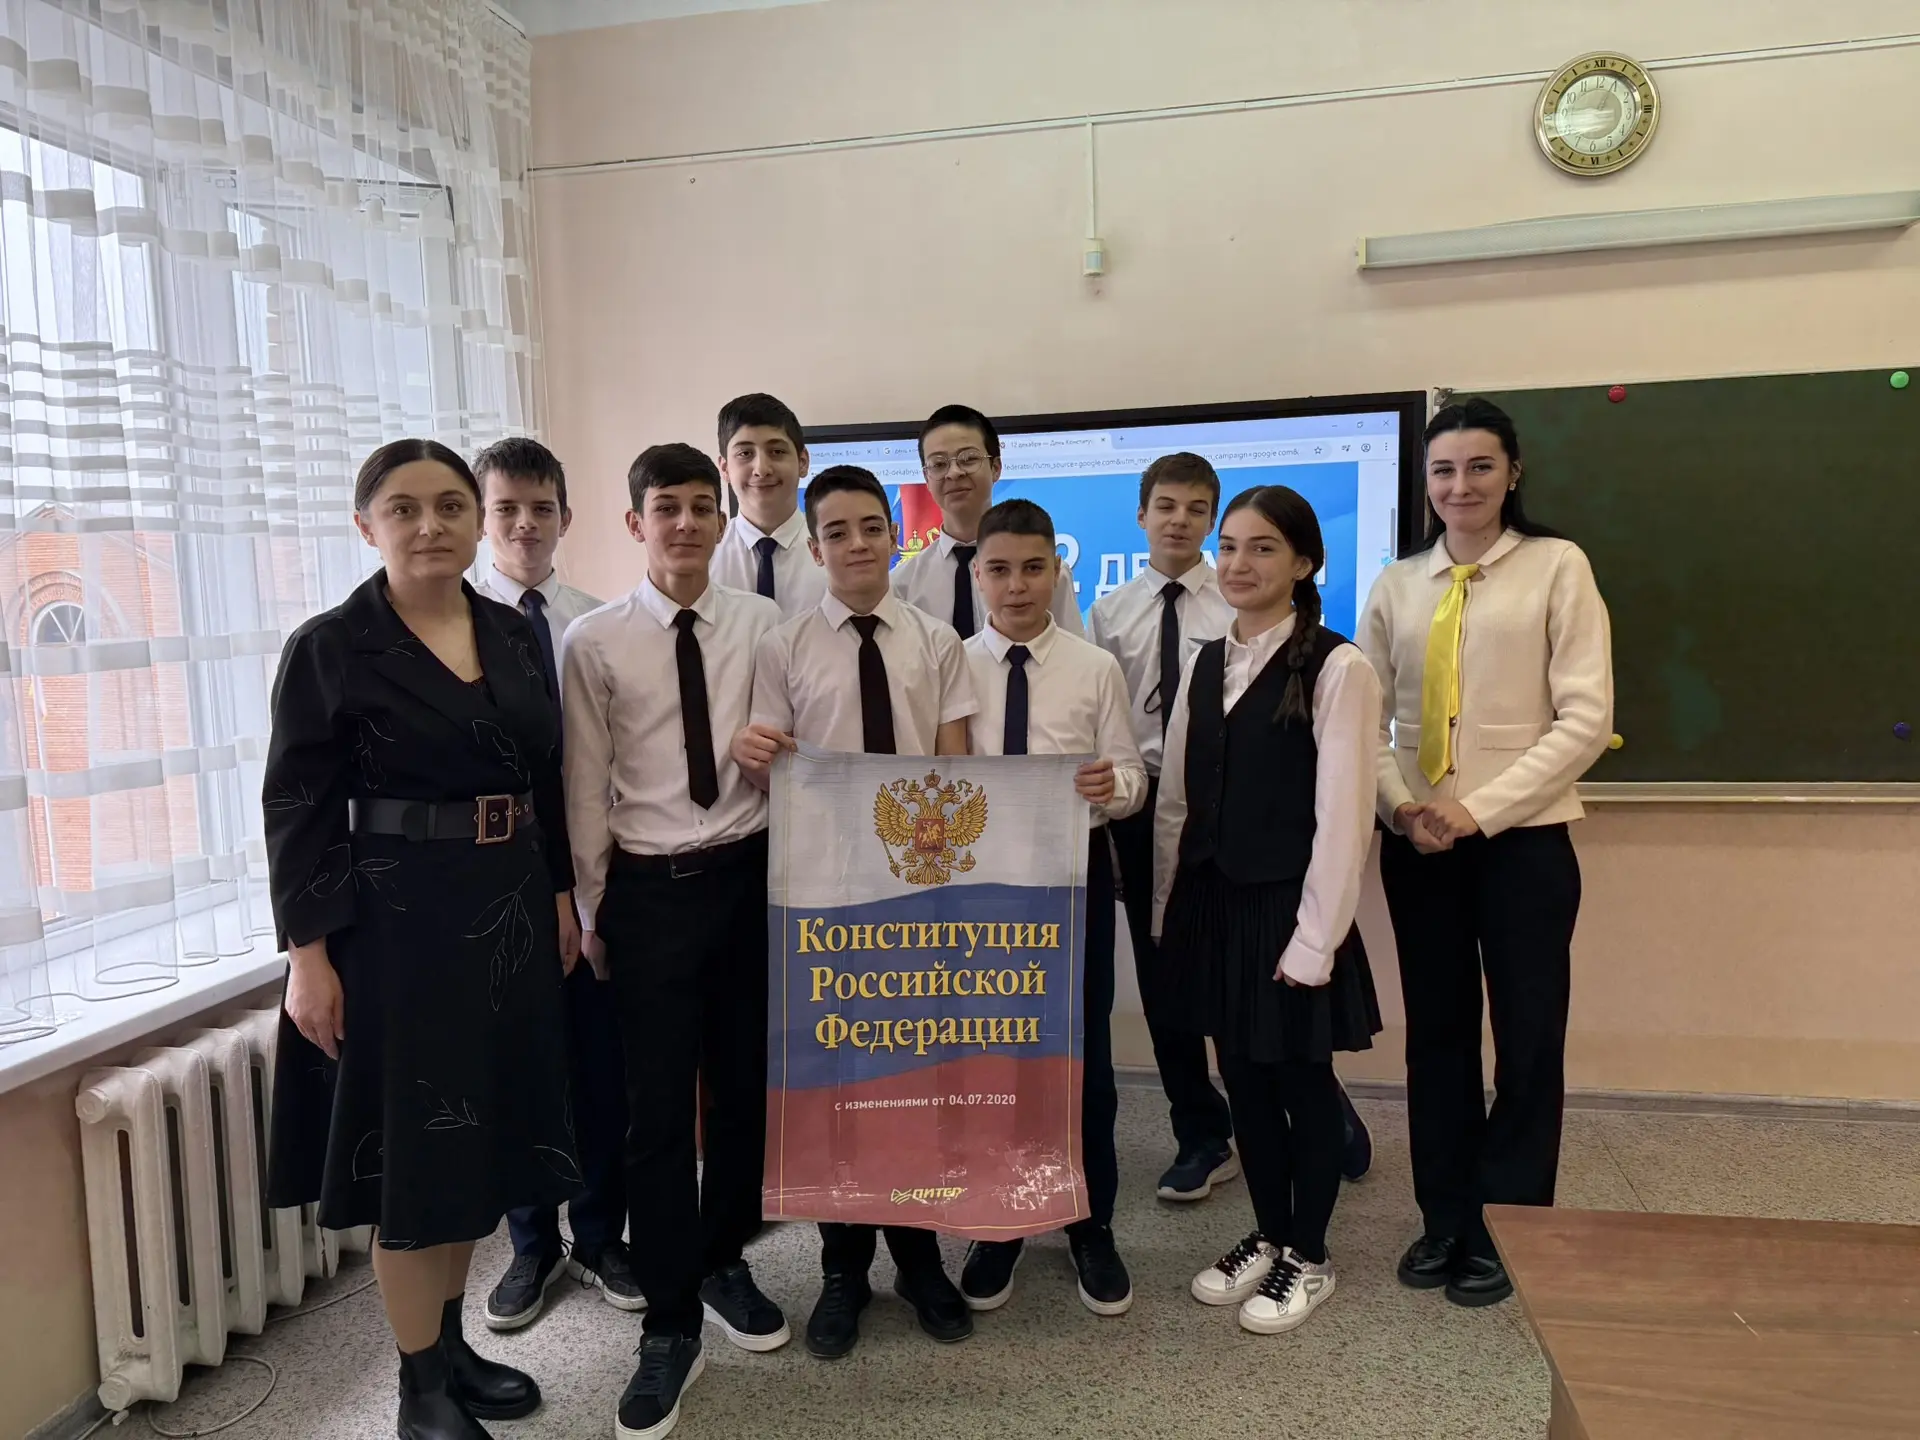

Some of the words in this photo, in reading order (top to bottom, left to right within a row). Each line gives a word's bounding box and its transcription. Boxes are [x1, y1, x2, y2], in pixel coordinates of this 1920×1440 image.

[1594, 60, 1606, 68] XII
[1580, 81, 1588, 93] 11
[1596, 76, 1605, 89] 12
[1566, 92, 1577, 105] 10
[1623, 91, 1629, 104] 2
[1626, 108, 1632, 120] 3
[1589, 141, 1596, 153] 6
[1606, 136, 1612, 148] 5
[797, 917, 1060, 958] Конституция
[809, 960, 1046, 1002] Российской
[815, 1013, 1040, 1056] Федерации
[834, 1102, 841, 1111] с
[845, 1098, 928, 1110] изменениями
[932, 1097, 945, 1106] от
[949, 1094, 1016, 1106] 04.07.2020
